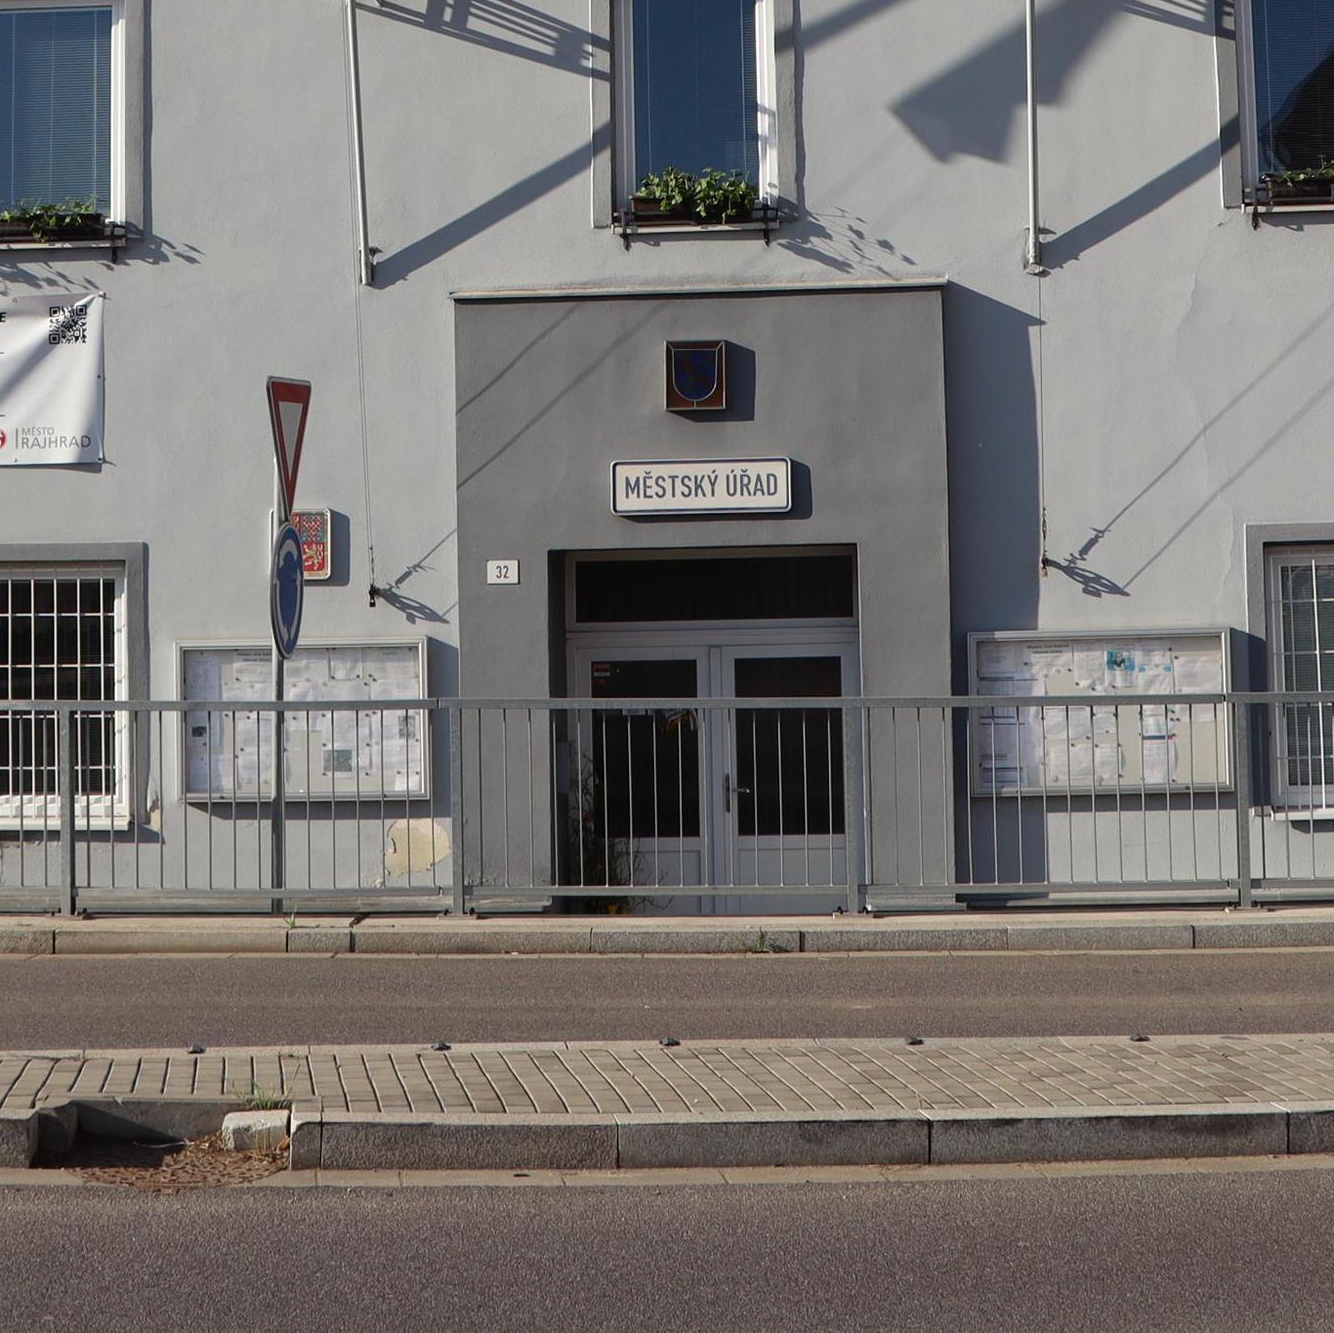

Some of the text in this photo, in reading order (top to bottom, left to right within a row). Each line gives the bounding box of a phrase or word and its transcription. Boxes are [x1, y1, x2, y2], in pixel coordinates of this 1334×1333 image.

[21, 426, 55, 436] MĚSTO
[21, 435, 91, 450] RAJHRAD
[625, 468, 778, 500] MĚSTSKÝ ÚŘAD
[496, 565, 509, 578] 32
